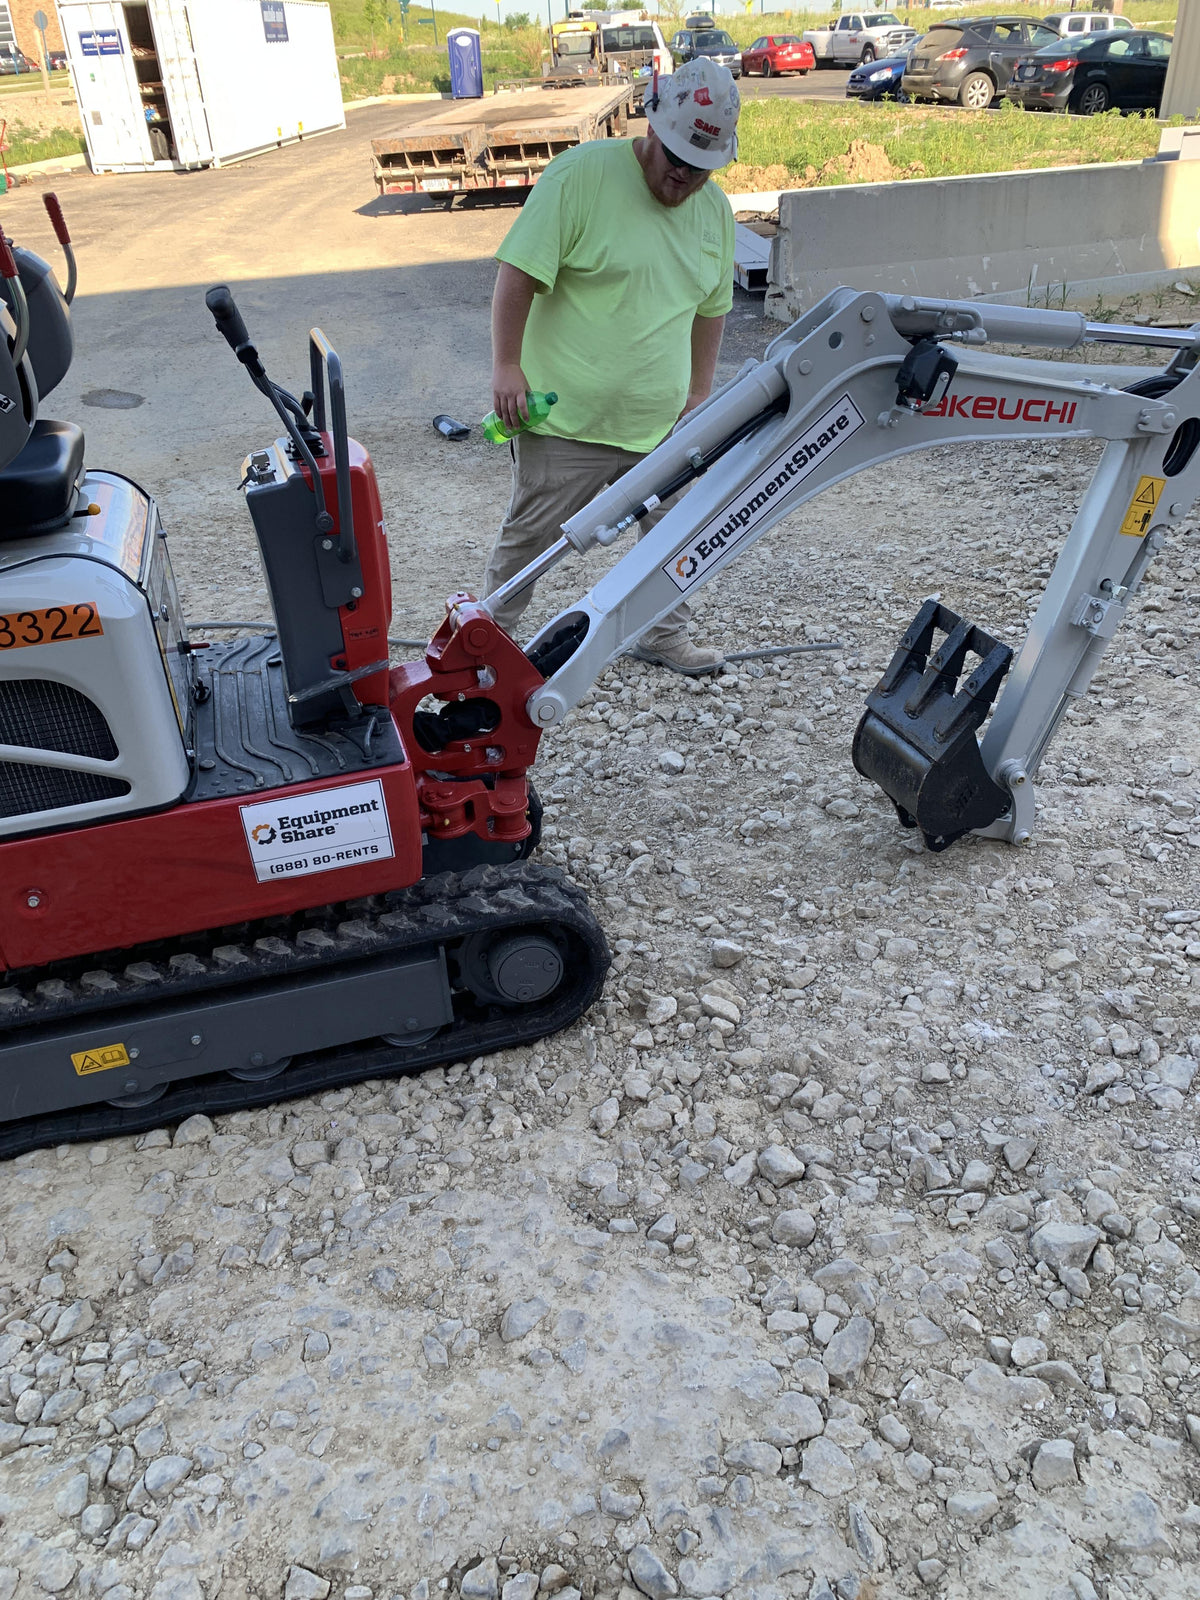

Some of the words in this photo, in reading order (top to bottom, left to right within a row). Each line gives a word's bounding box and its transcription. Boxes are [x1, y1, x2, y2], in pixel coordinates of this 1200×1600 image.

[694, 118, 721, 137] SME
[278, 799, 379, 829] Equipment
[270, 858, 308, 874] (888)
[312, 845, 379, 866] 80-RENTS
